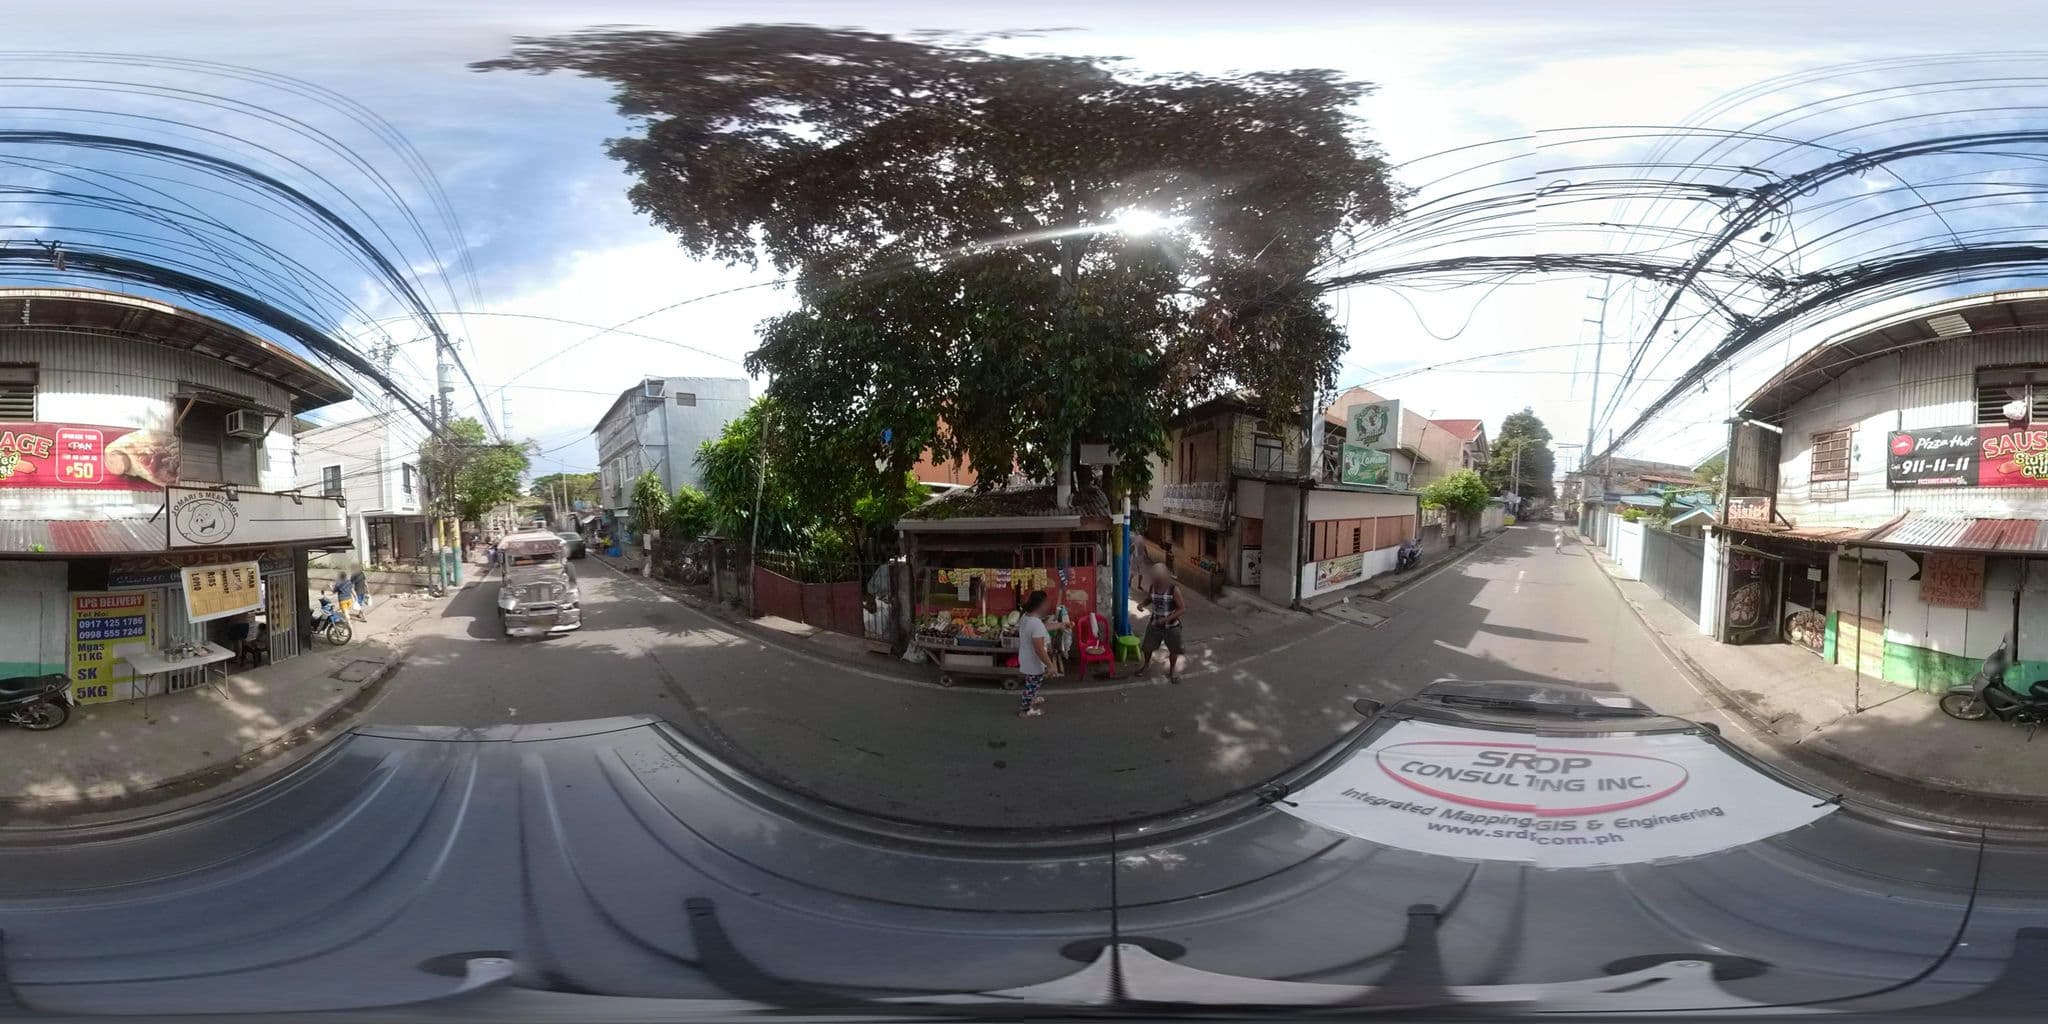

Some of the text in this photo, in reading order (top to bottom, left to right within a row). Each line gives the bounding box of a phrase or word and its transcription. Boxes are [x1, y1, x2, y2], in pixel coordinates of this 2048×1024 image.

[1915, 434, 1976, 450] Pizza Hut
[1901, 457, 1970, 475] 911-11-11
[191, 573, 202, 593] LOMO
[207, 571, 217, 587] RIBS
[1940, 569, 1982, 588] RENT
[100, 594, 143, 607] DELIVERY
[79, 620, 101, 629] 0917
[104, 619, 120, 627] 125
[79, 630, 101, 639] 0998
[104, 629, 120, 637] 555
[76, 686, 107, 699] 5KG
[1400, 761, 1652, 792] CONSULTING INC.
[1340, 788, 1437, 816] Integrated
[1587, 820, 1604, 831] &
[1613, 806, 1725, 829] Engineering
